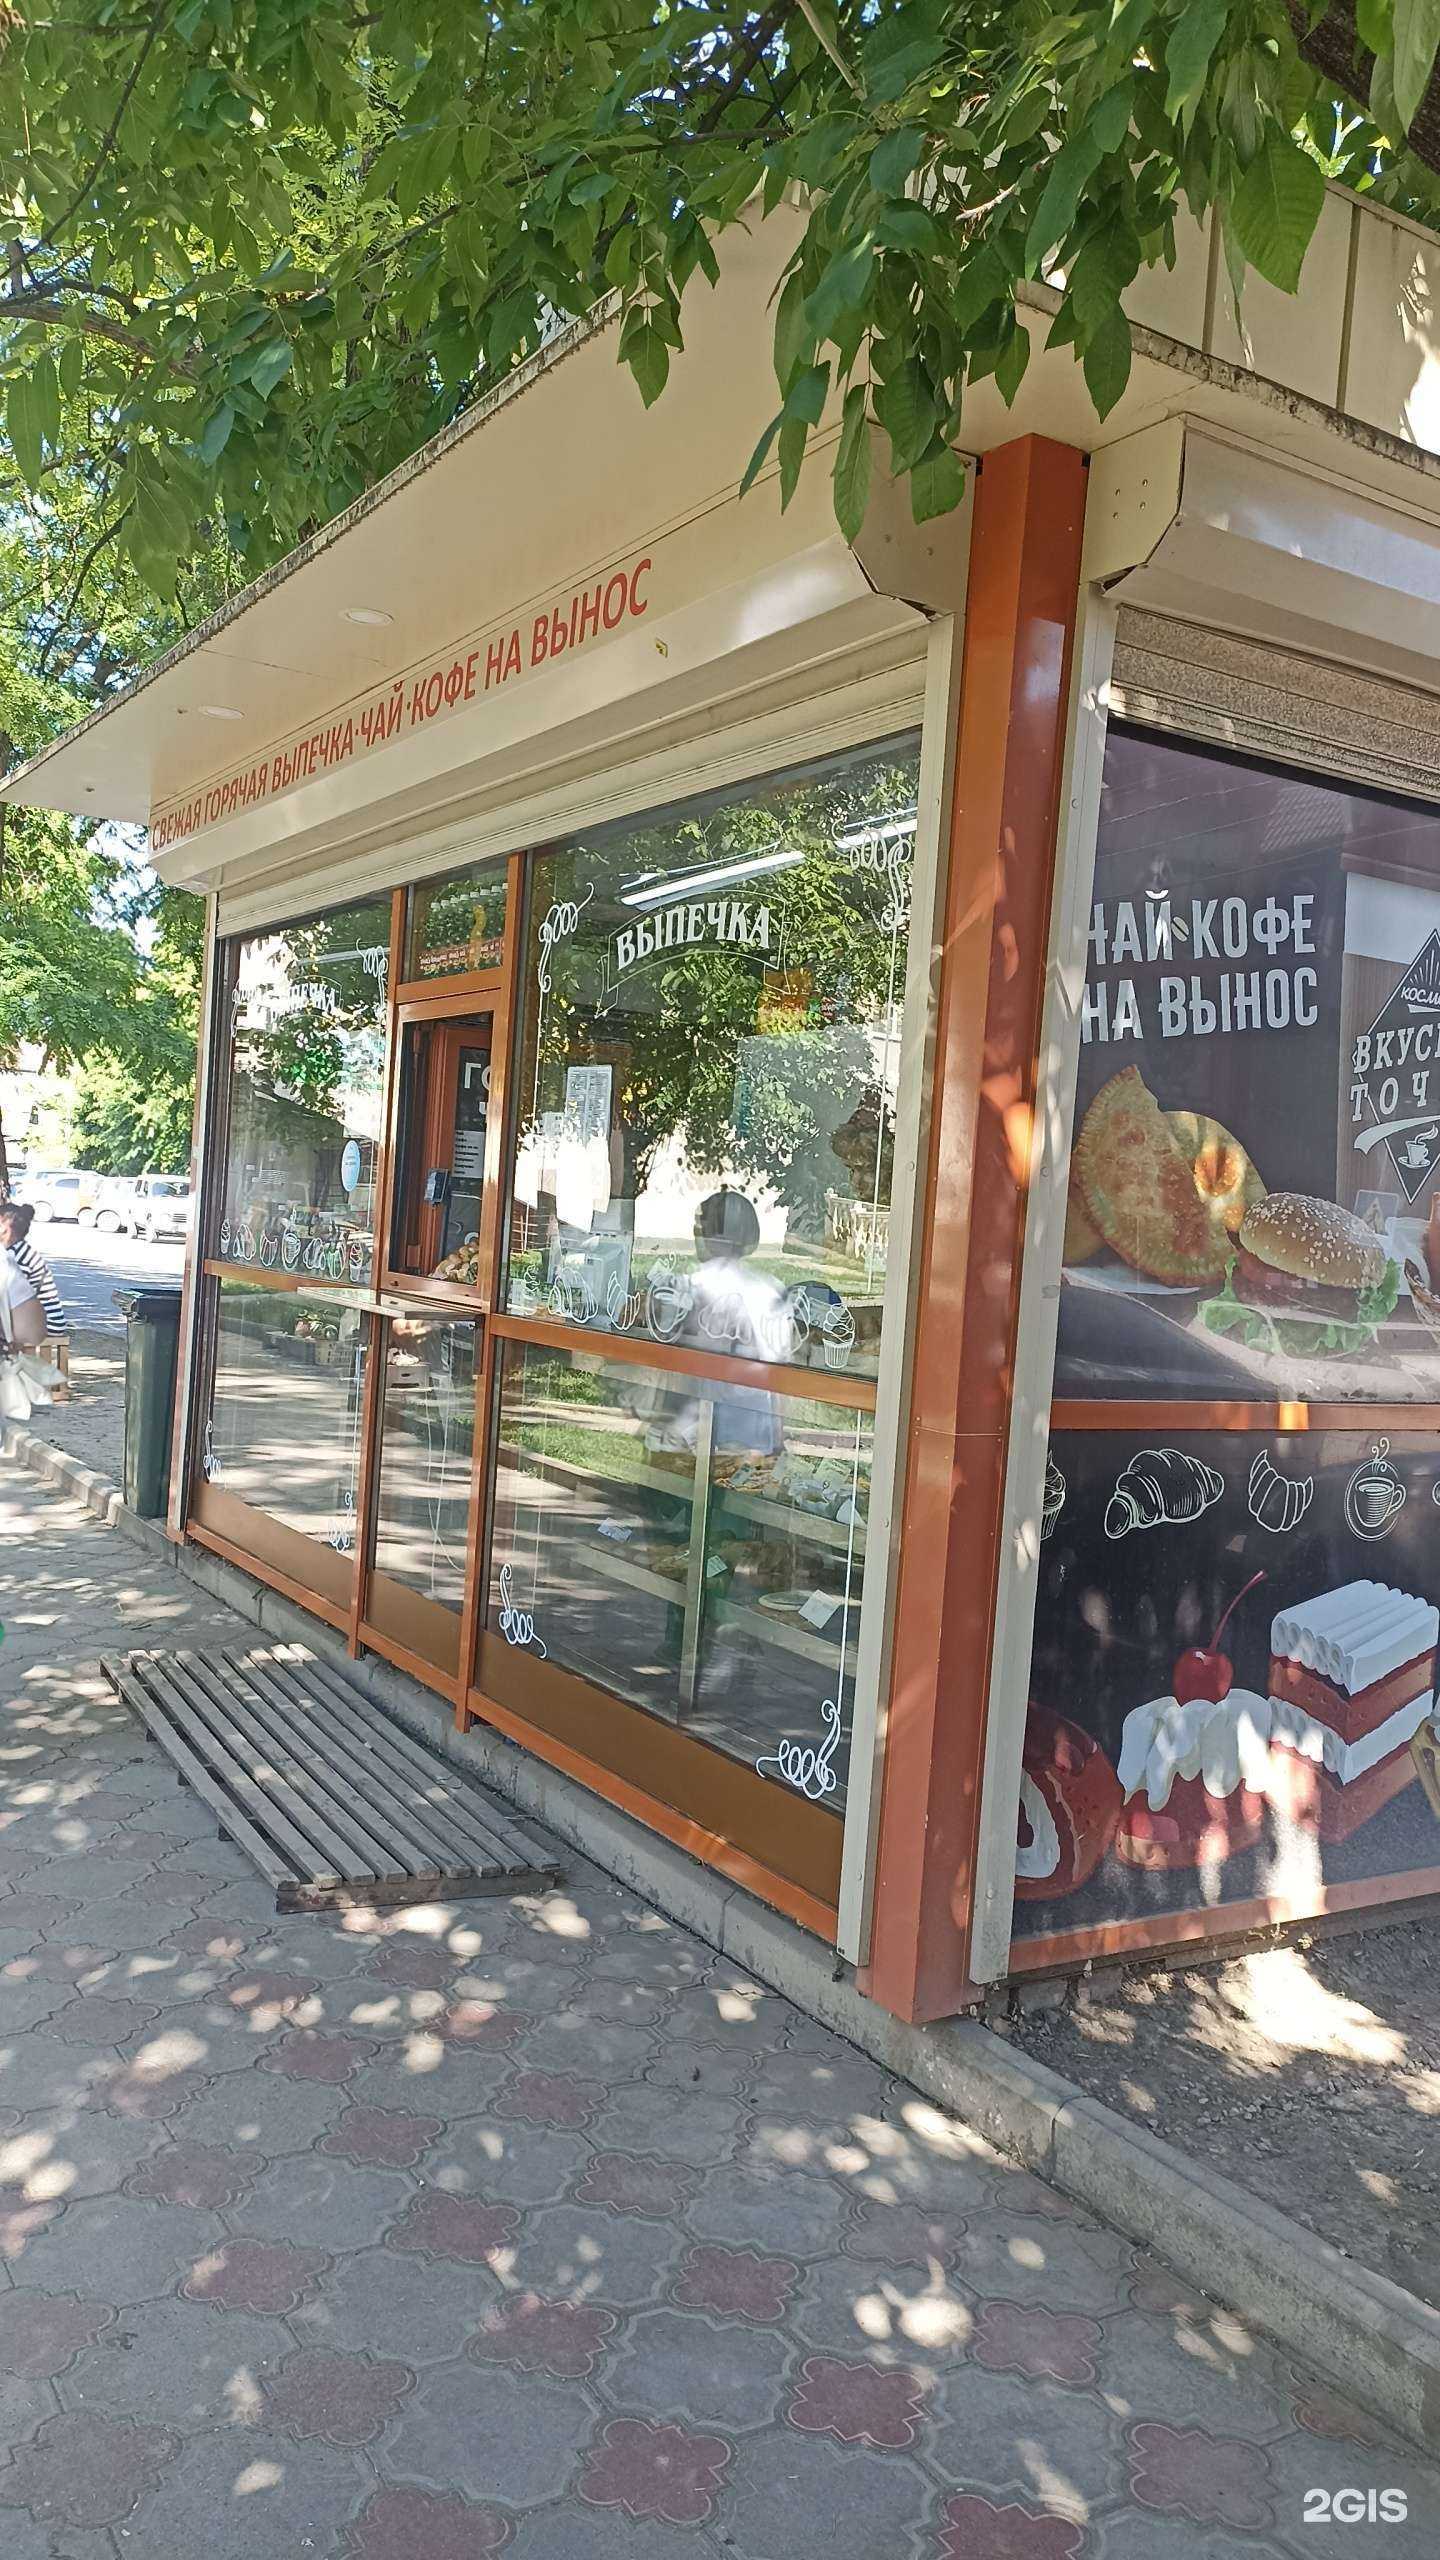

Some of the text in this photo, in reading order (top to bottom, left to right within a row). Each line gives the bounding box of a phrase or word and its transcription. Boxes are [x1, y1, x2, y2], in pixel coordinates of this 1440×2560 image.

[152, 798, 202, 850] СВЕЖАЯ
[204, 763, 269, 825] ГОРЯЧАЯ
[485, 629, 522, 690] НА
[531, 558, 651, 667] ВЫНОС
[615, 902, 770, 971] ВЫПЕЧКА
[1192, 894, 1316, 960] КОФЕ
[1082, 966, 1318, 1044] НА ВЫНОС
